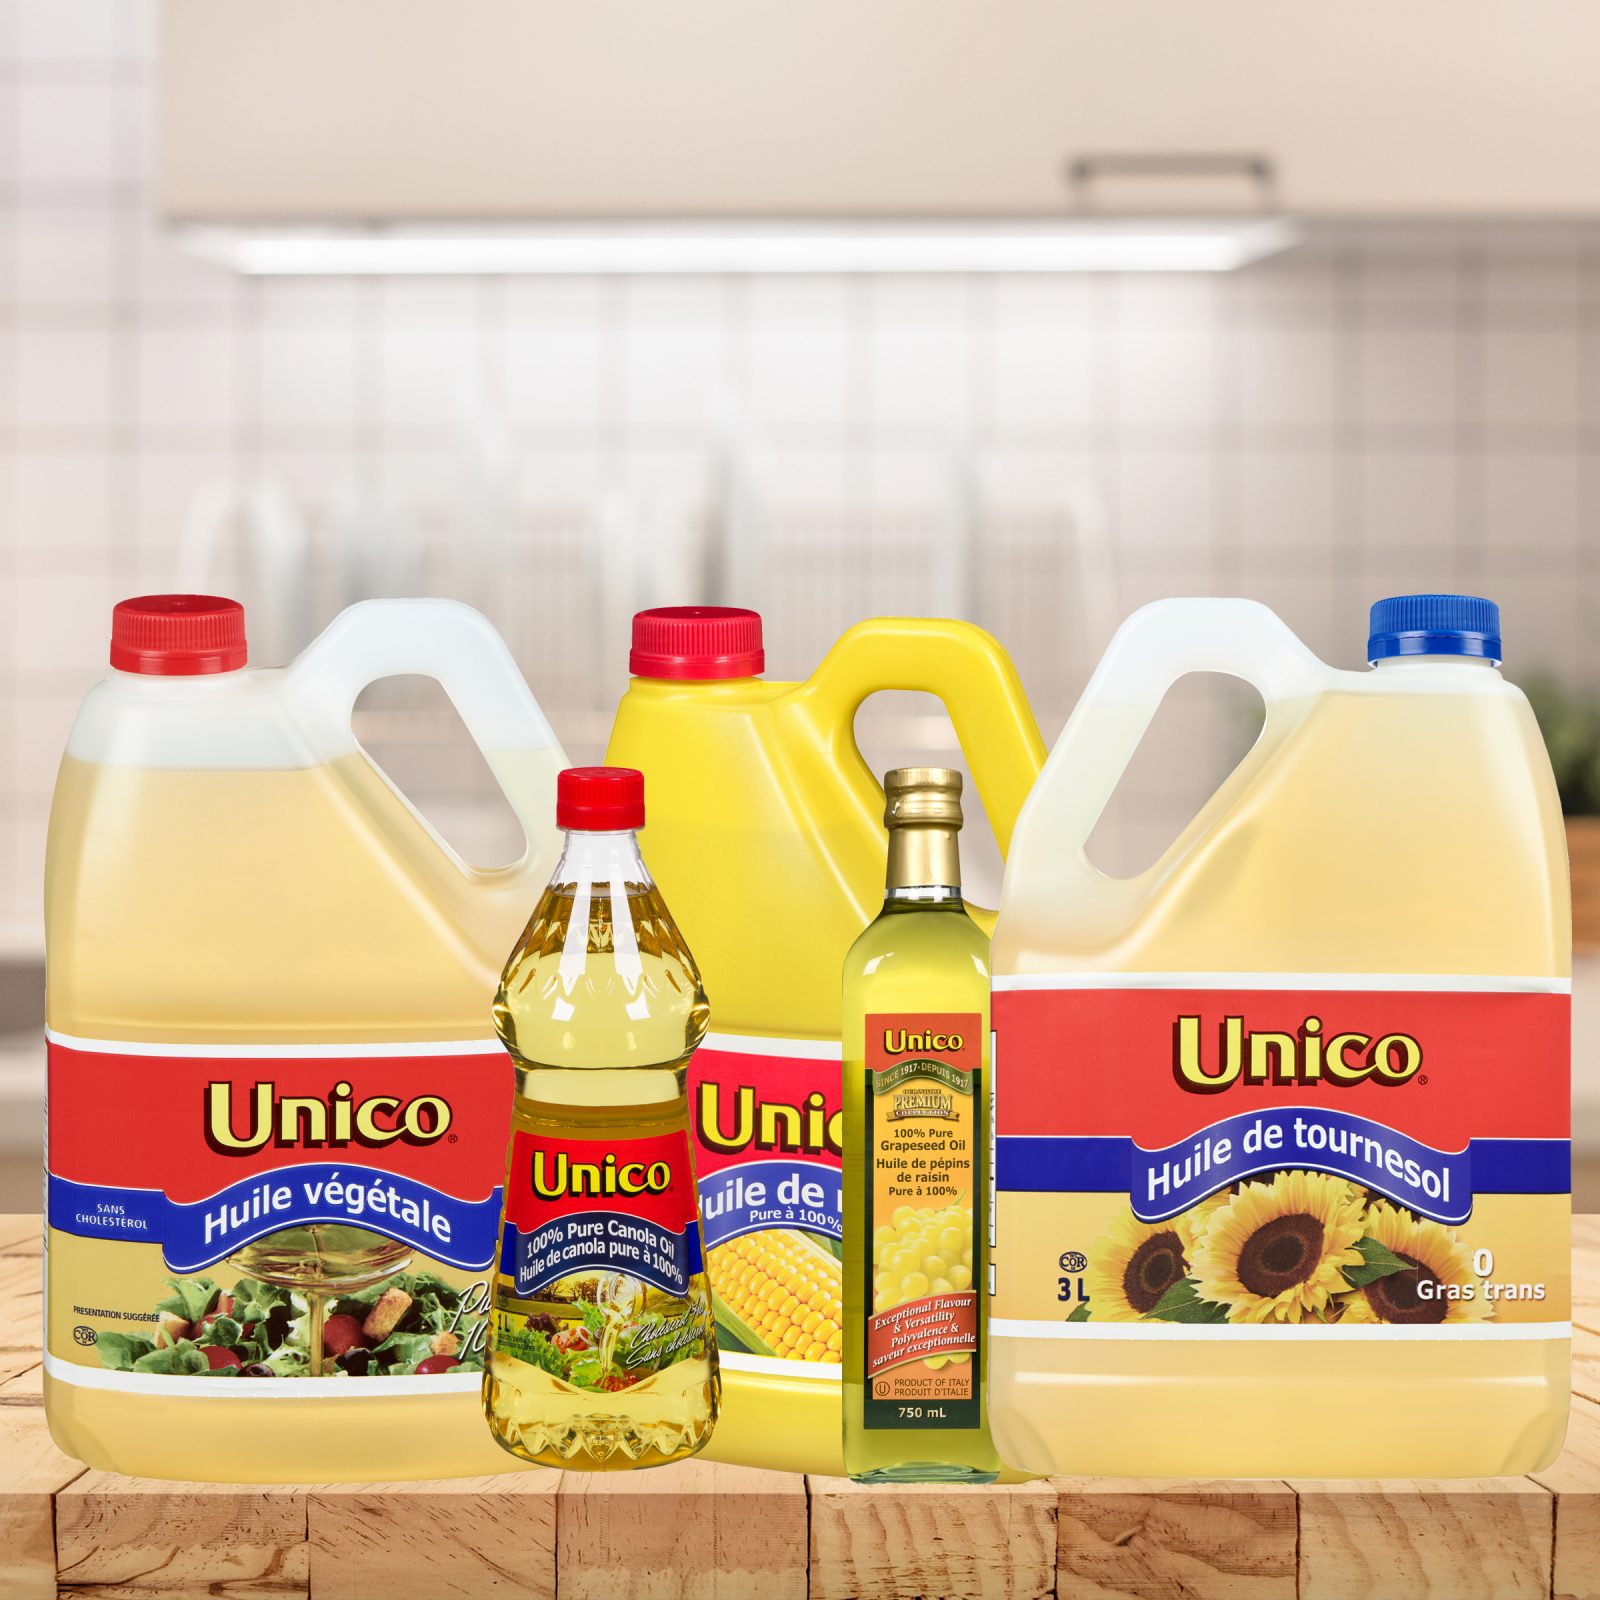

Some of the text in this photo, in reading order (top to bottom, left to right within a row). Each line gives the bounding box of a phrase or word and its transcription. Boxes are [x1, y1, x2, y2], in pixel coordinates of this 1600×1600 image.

[884, 1029, 963, 1055] Unico
[1172, 1015, 1423, 1095] Unico
[877, 1070, 898, 1088] SINCE
[952, 1074, 968, 1088] 1917
[893, 1094, 953, 1111] PREMIUM
[204, 1081, 453, 1157] Unico
[894, 1128, 953, 1138] 100% Pure
[881, 1140, 966, 1153] Grapeseed Oil
[1147, 1117, 1450, 1202] Huile de tournesol
[532, 1150, 671, 1202] Unico
[876, 1157, 970, 1171] Huile de pépins
[777, 1173, 825, 1208] de
[896, 1172, 950, 1183] de raisin
[889, 1186, 957, 1196] Pure à 100%
[97, 1203, 125, 1215] SANS
[204, 1171, 452, 1245] Huile végétale
[750, 1206, 842, 1233] Pure à 100%
[527, 1219, 675, 1260] 100% Pure Canola Oil
[519, 1237, 683, 1285] Huile de canola pure à 100%
[1473, 1248, 1494, 1278] 0
[1416, 1279, 1546, 1301] Gras trans
[73, 1305, 160, 1323] PRESENTATION SUGGÉRÉE
[874, 1298, 972, 1331] Exceptional Flavour
[893, 1311, 955, 1334] & Versatility
[890, 1322, 959, 1348] Polyvalence &
[626, 1342, 663, 1370] Sans
[872, 1332, 977, 1368] saveur exceptionnelle
[894, 1378, 970, 1387] PRODUCT OF ITALY
[894, 1387, 969, 1396] PRODUIT D'ITALIE
[898, 1407, 947, 1418] 750 mL
